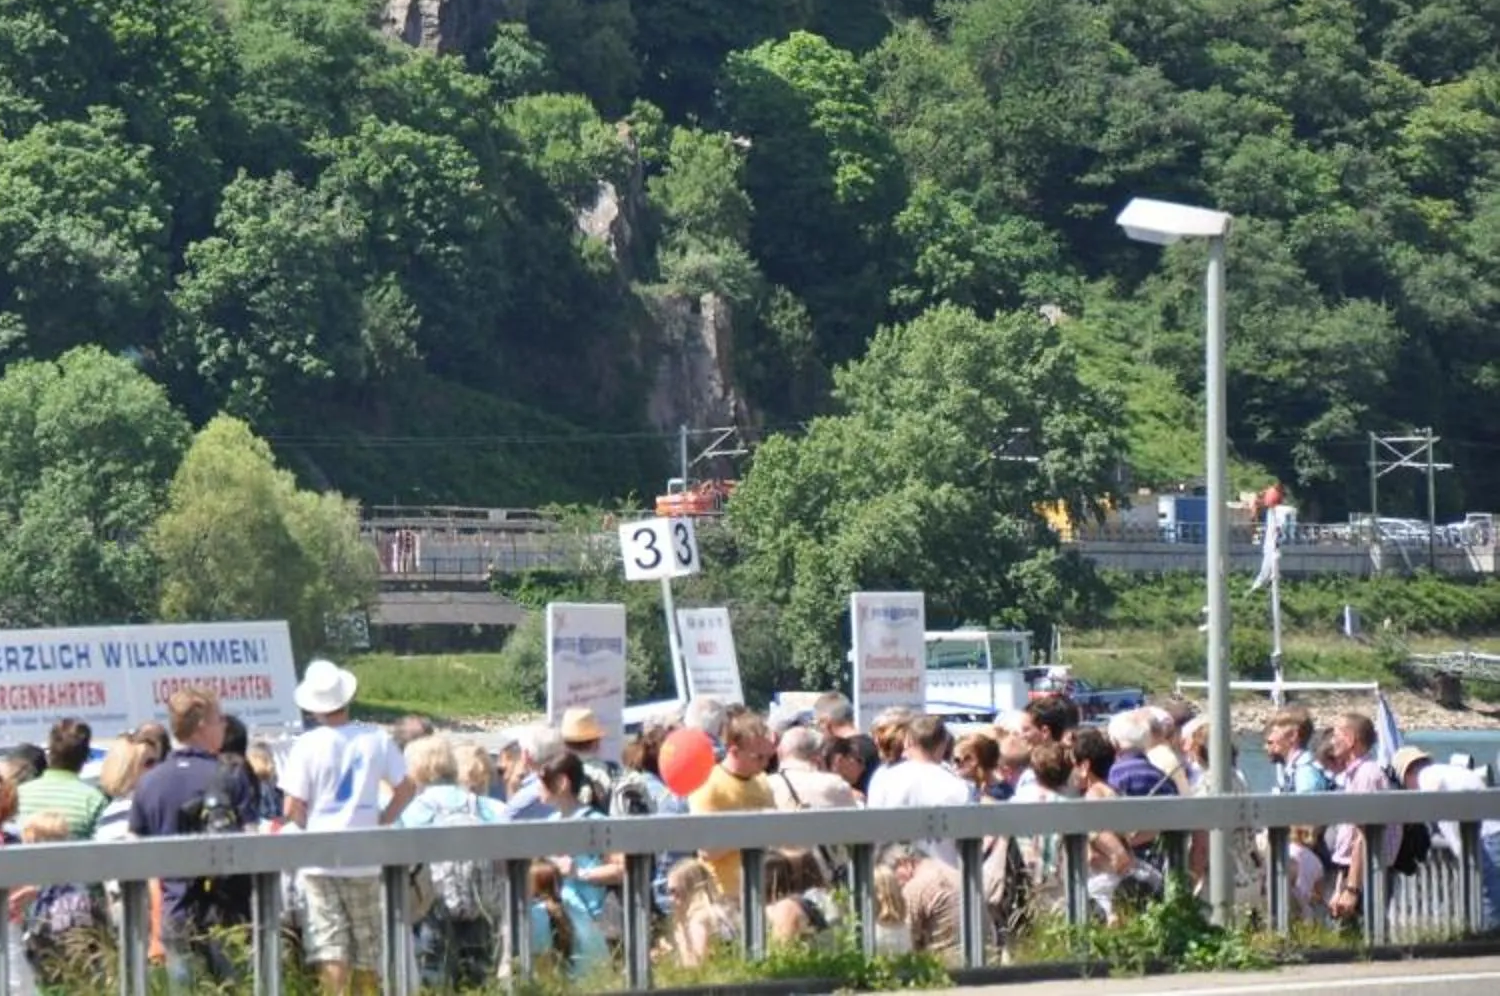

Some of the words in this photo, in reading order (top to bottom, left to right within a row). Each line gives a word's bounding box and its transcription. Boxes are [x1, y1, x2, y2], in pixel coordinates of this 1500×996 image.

[632, 527, 662, 570] 3
[674, 522, 693, 567] 3
[100, 638, 269, 669] WILLKOMMEN!
